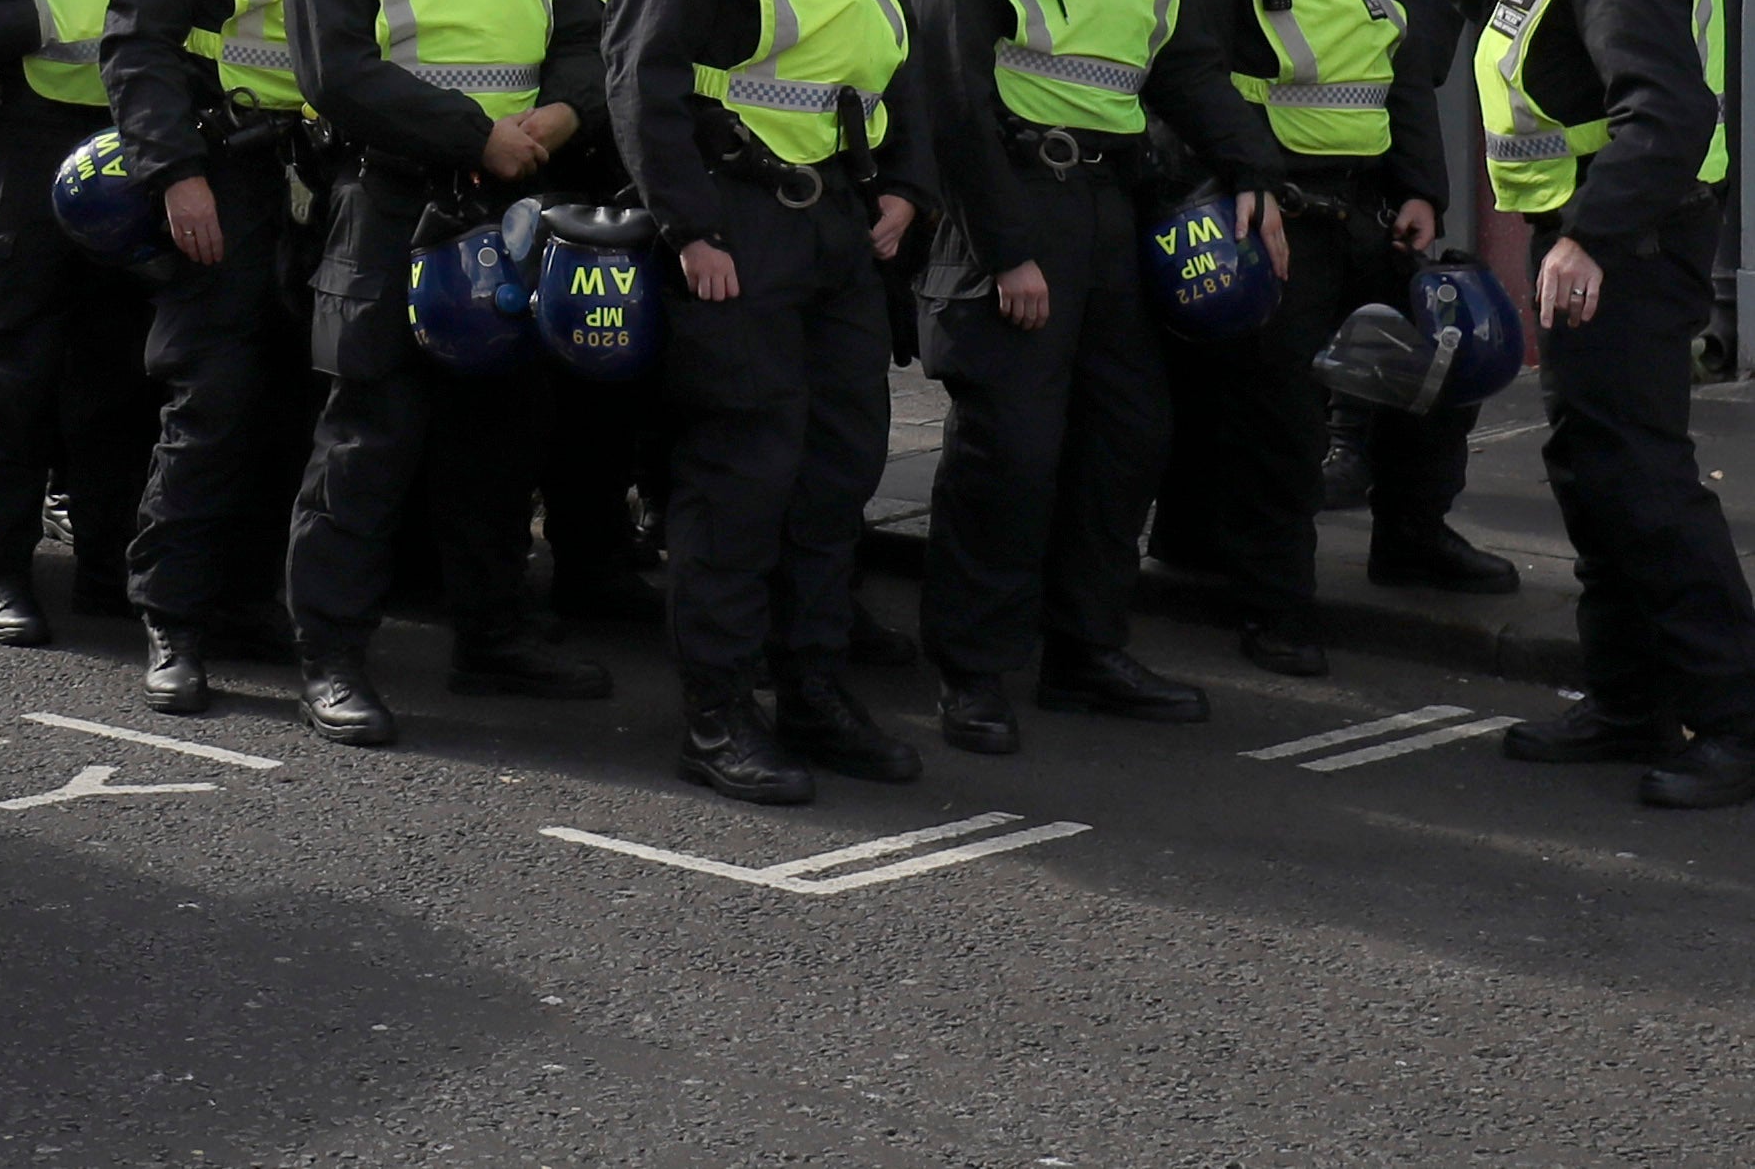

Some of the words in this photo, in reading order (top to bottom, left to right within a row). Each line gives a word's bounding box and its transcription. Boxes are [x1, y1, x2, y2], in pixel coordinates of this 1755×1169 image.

[1155, 216, 1223, 256] WA
[1181, 252, 1217, 280] MP
[570, 266, 637, 296] AW
[1176, 273, 1231, 304] 4872
[585, 307, 623, 328] MP
[573, 329, 629, 347] 9209
